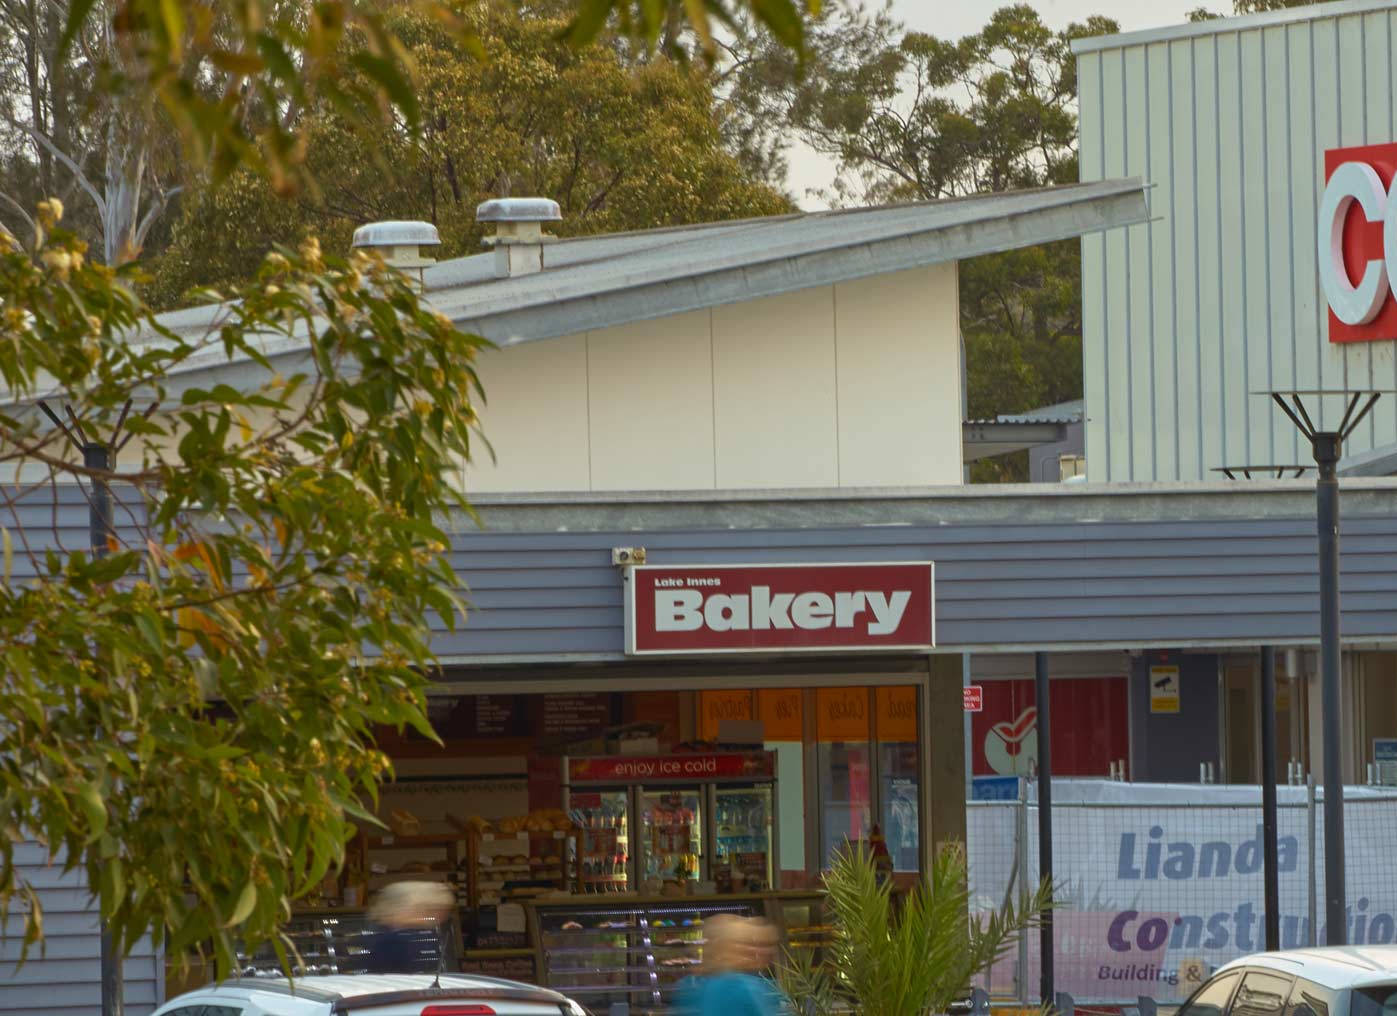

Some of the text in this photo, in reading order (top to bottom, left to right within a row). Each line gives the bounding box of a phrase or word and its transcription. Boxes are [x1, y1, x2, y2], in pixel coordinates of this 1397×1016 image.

[654, 577, 721, 587] Lake Innes
[654, 585, 912, 635] Bakery
[615, 758, 717, 776] enjoy ice cold
[1117, 824, 1299, 880] Lianda
[1098, 963, 1180, 986] Building
[1186, 965, 1203, 982] &
